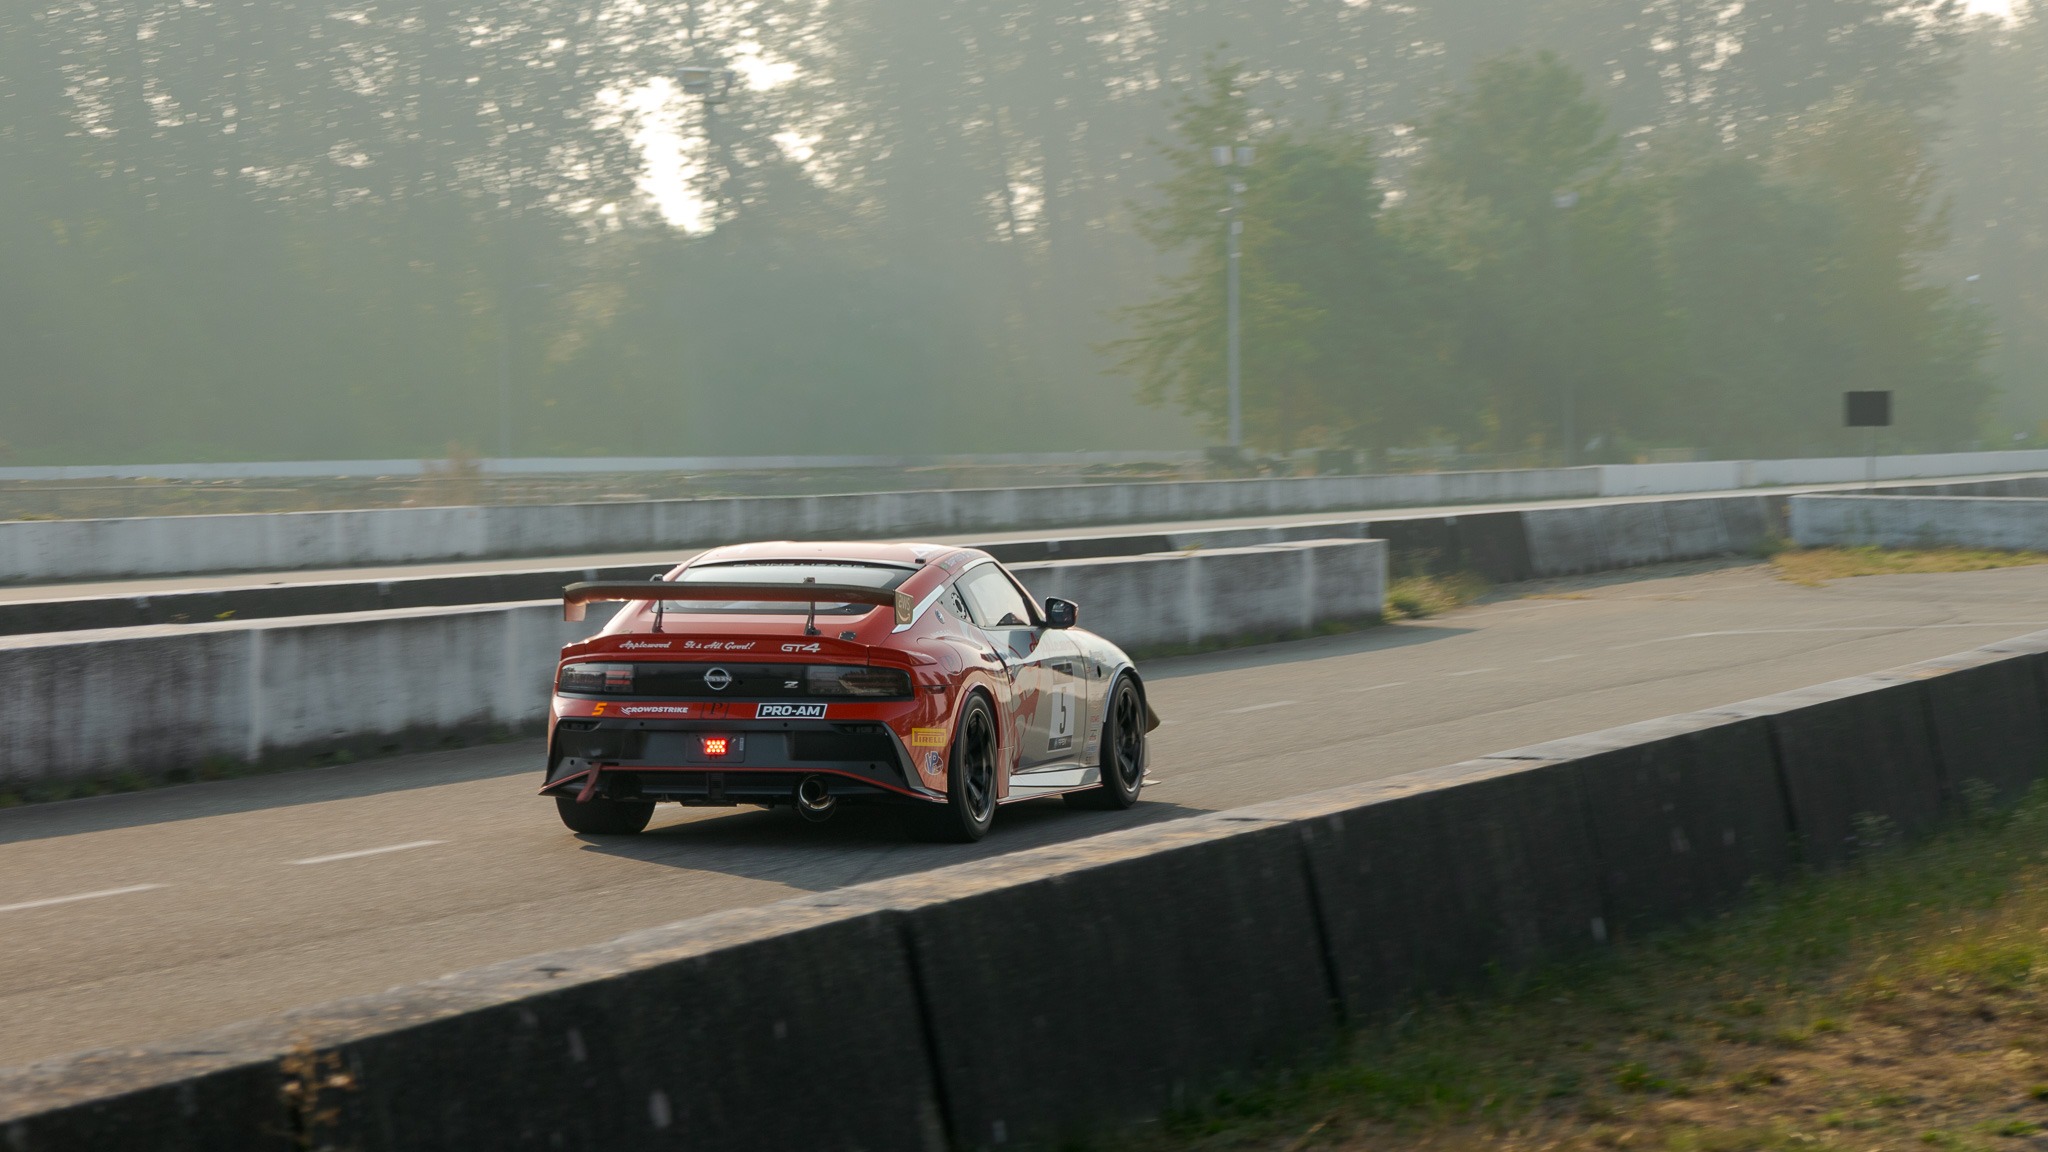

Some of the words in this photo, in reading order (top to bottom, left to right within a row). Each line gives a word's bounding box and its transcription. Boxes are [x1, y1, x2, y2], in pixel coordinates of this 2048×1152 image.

[619, 640, 672, 650] Applewood
[703, 641, 723, 650] All
[724, 641, 756, 651] Good!
[781, 642, 821, 653] GT4
[784, 681, 799, 689] Z
[591, 702, 608, 716] 5
[625, 706, 689, 714] CROWDSTRIKE
[761, 705, 821, 716] PRO-AM
[1059, 687, 1067, 734] 5
[914, 731, 945, 744] PIRELLI
